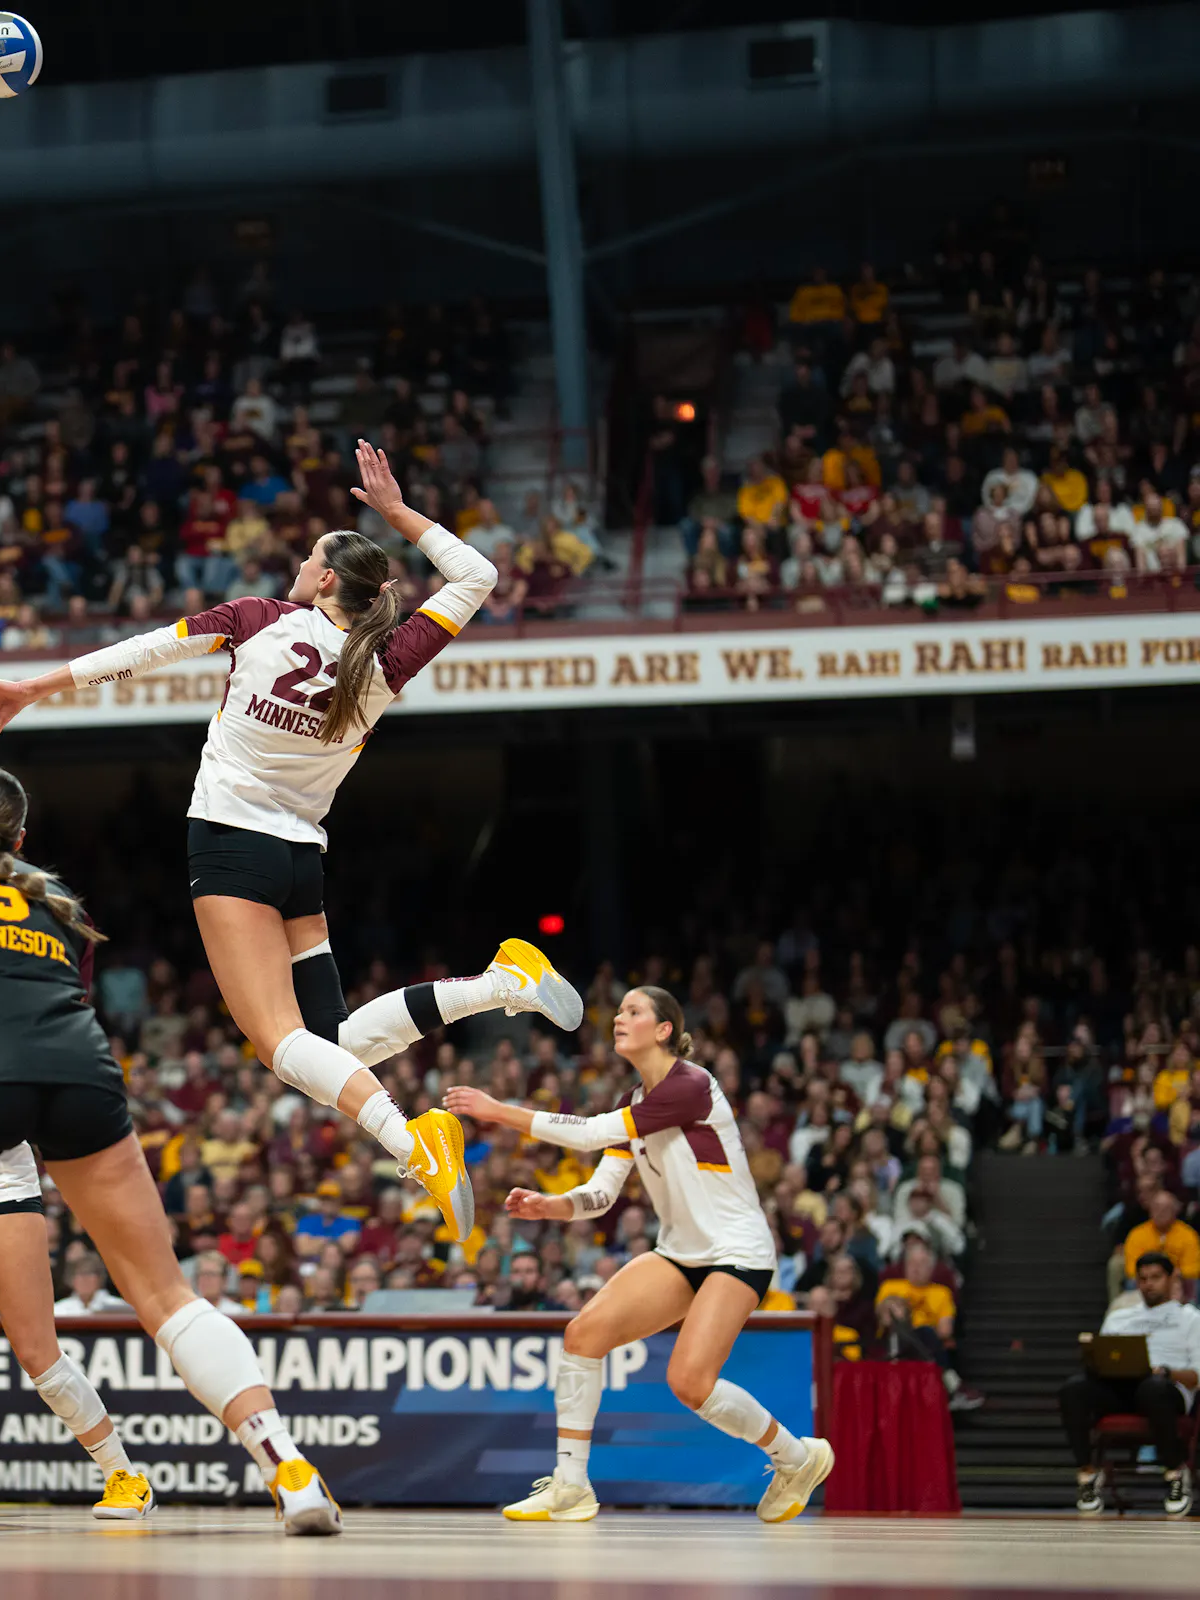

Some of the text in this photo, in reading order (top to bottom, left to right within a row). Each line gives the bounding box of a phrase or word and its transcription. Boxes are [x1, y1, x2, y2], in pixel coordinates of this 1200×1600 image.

[432, 656, 597, 692] UNITED
[610, 651, 700, 687] ARE
[720, 646, 804, 682] WE.
[818, 649, 901, 679] RAH!
[913, 637, 1027, 676] RAH!
[1040, 639, 1128, 671] RAH!
[244, 693, 344, 744] MINNESO
